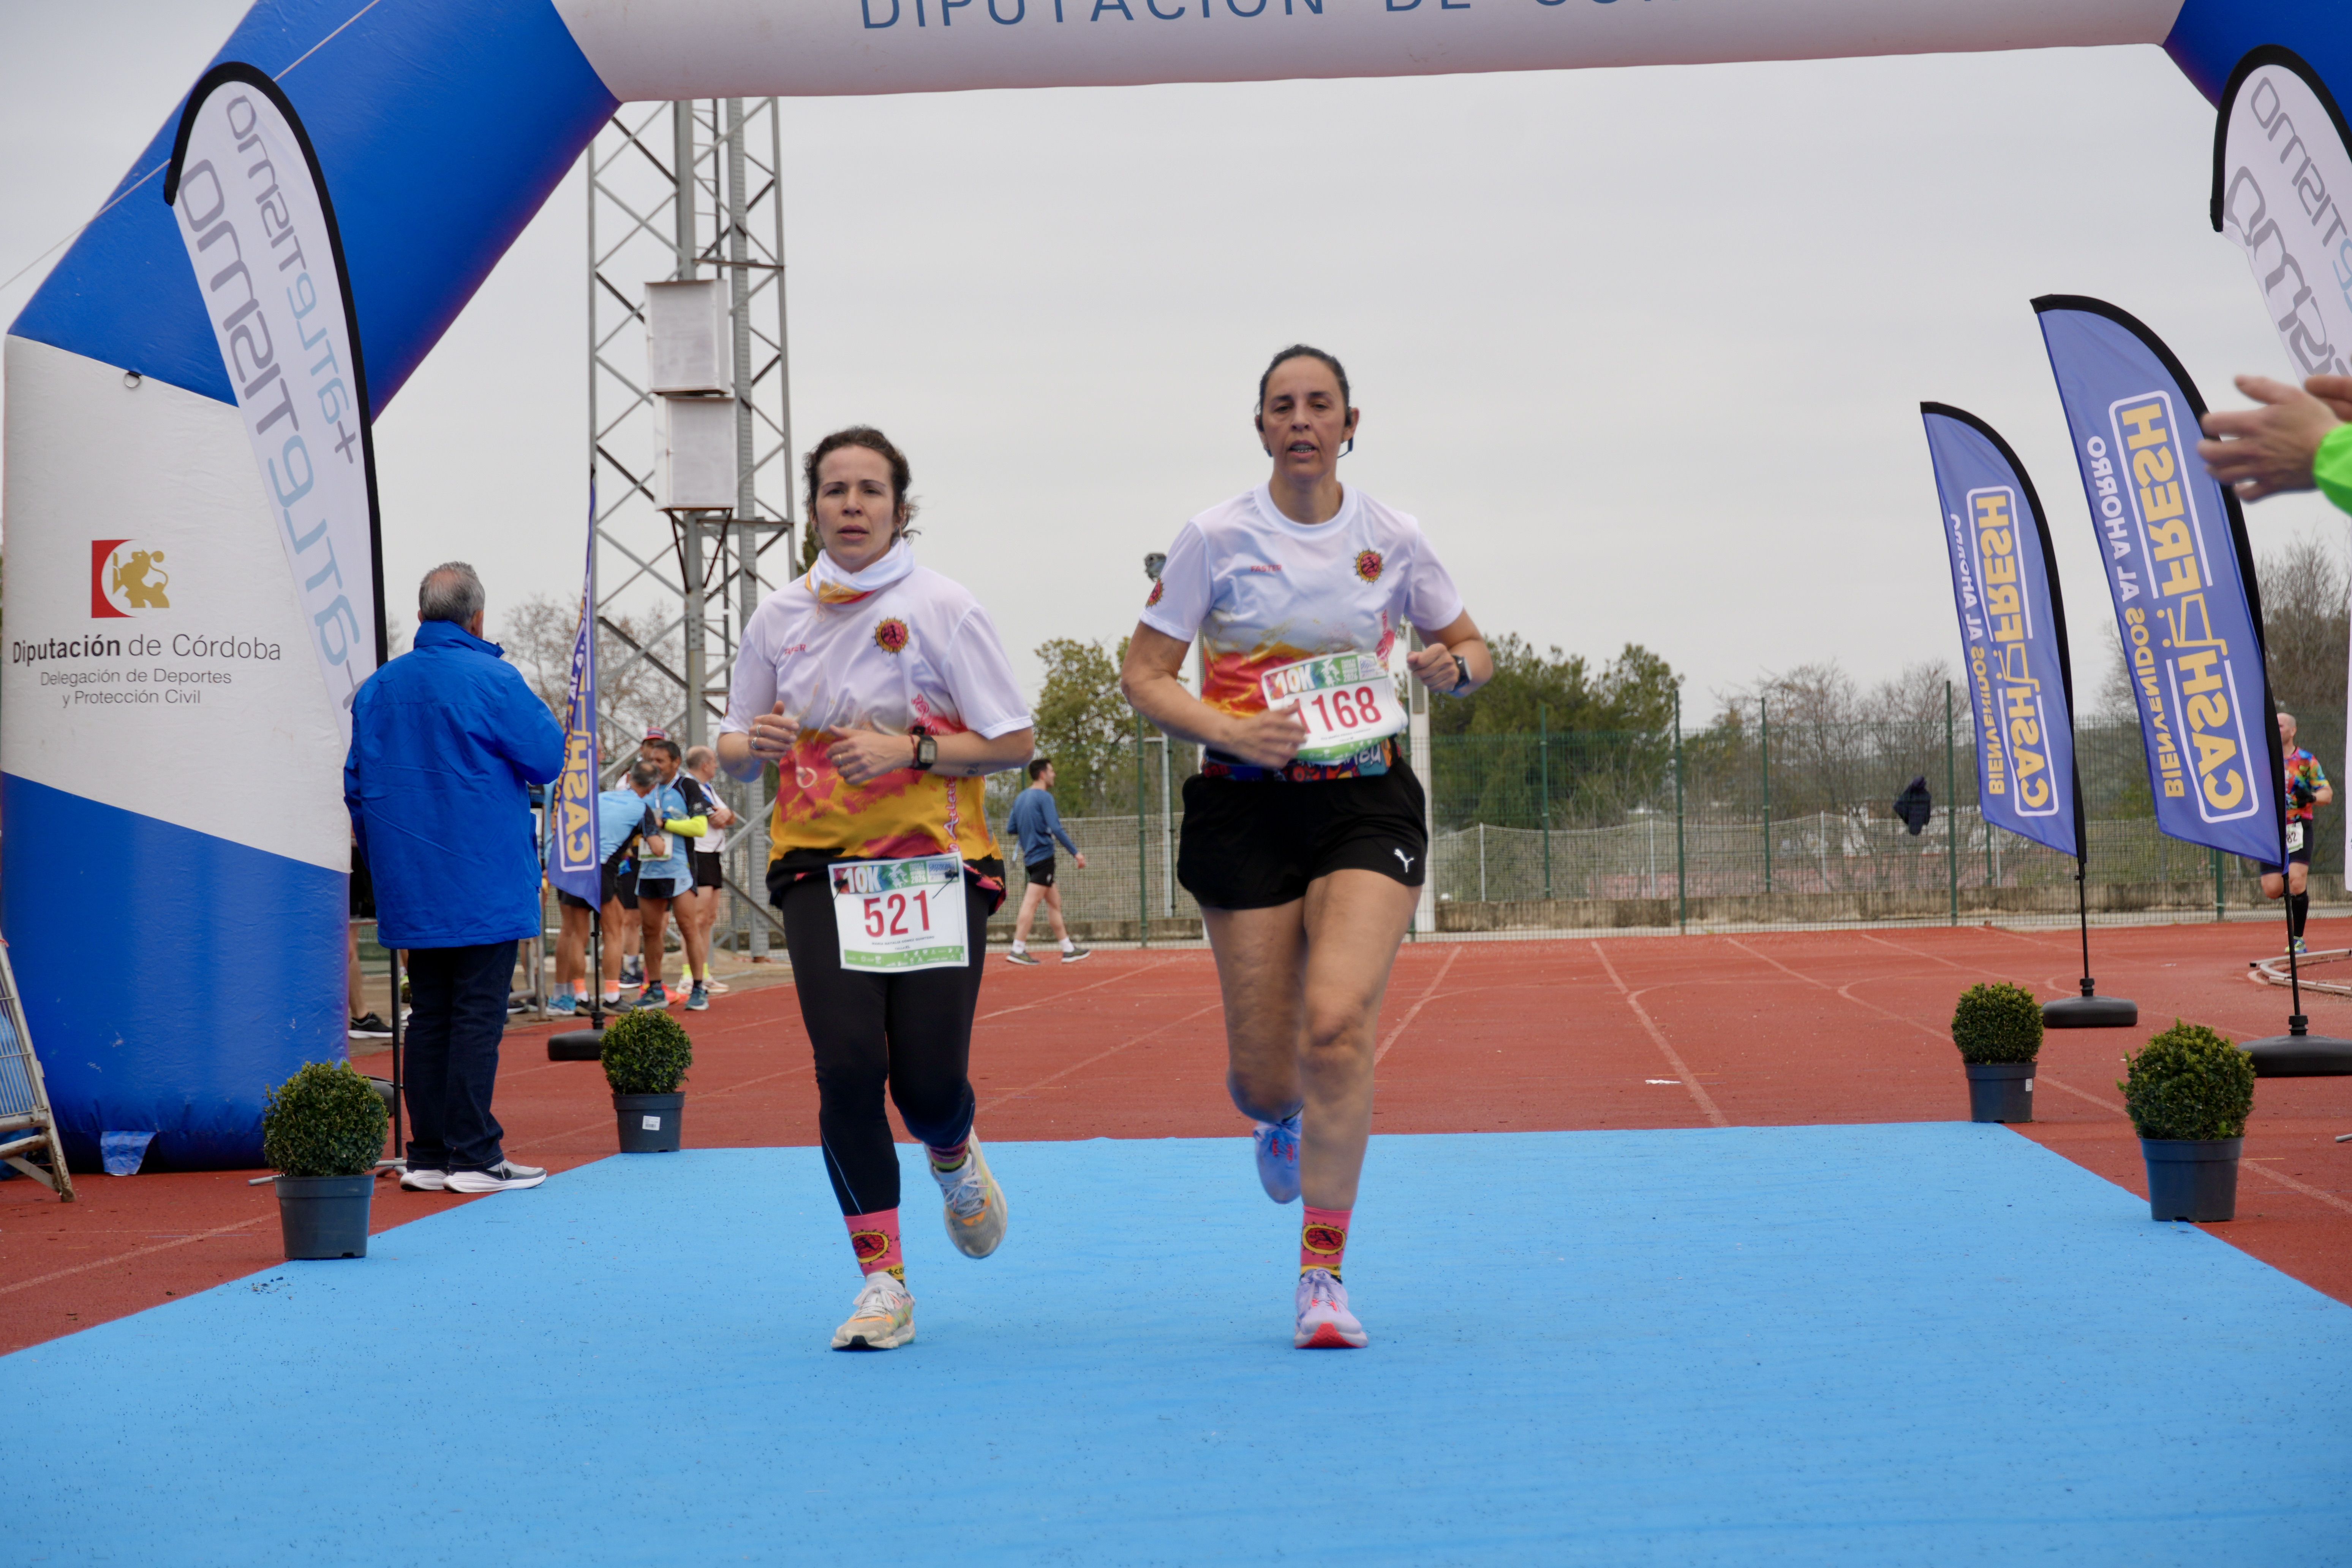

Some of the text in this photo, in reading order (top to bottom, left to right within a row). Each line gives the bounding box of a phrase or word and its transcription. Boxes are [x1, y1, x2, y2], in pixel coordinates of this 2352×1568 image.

[13, 634, 281, 666] Diputación de Córdoba
[41, 669, 232, 687] Delegación de Deportes
[1275, 664, 1316, 695] 10K
[62, 689, 201, 708] y Protección Civil
[1288, 686, 1382, 734] 1168
[843, 866, 882, 893] 10K
[864, 890, 930, 938] 521
